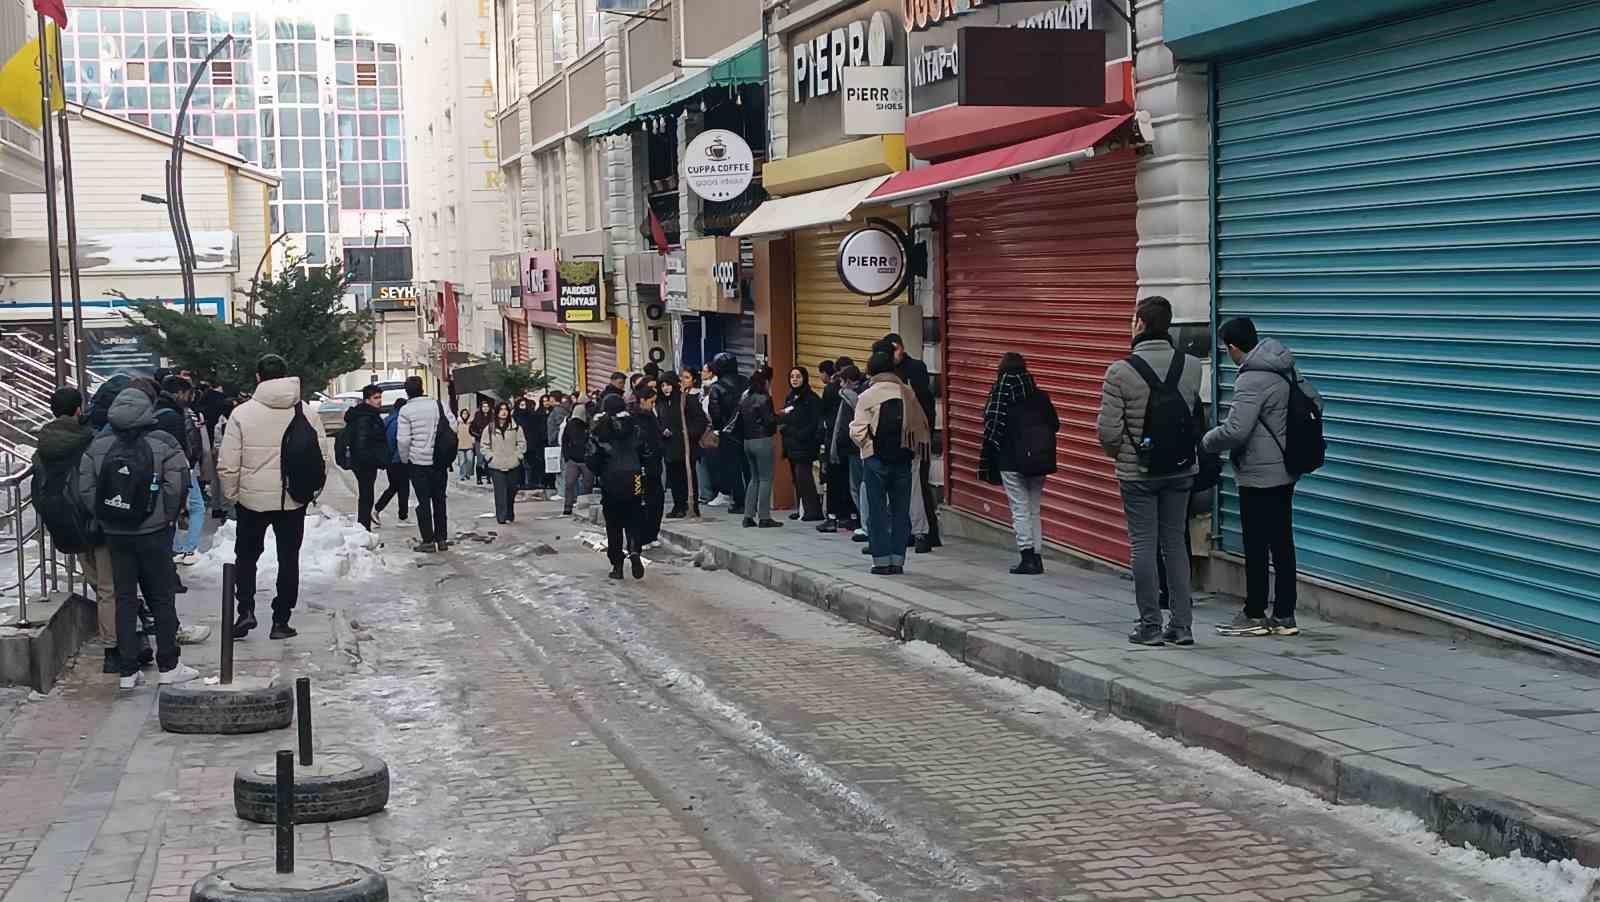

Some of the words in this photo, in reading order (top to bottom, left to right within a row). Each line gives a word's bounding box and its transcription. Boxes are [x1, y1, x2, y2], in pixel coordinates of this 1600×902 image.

[687, 165, 715, 174] CUPPA
[718, 163, 751, 172] COFFEE
[561, 284, 596, 296] PARDESÜ
[560, 296, 598, 307] DÜNYASI
